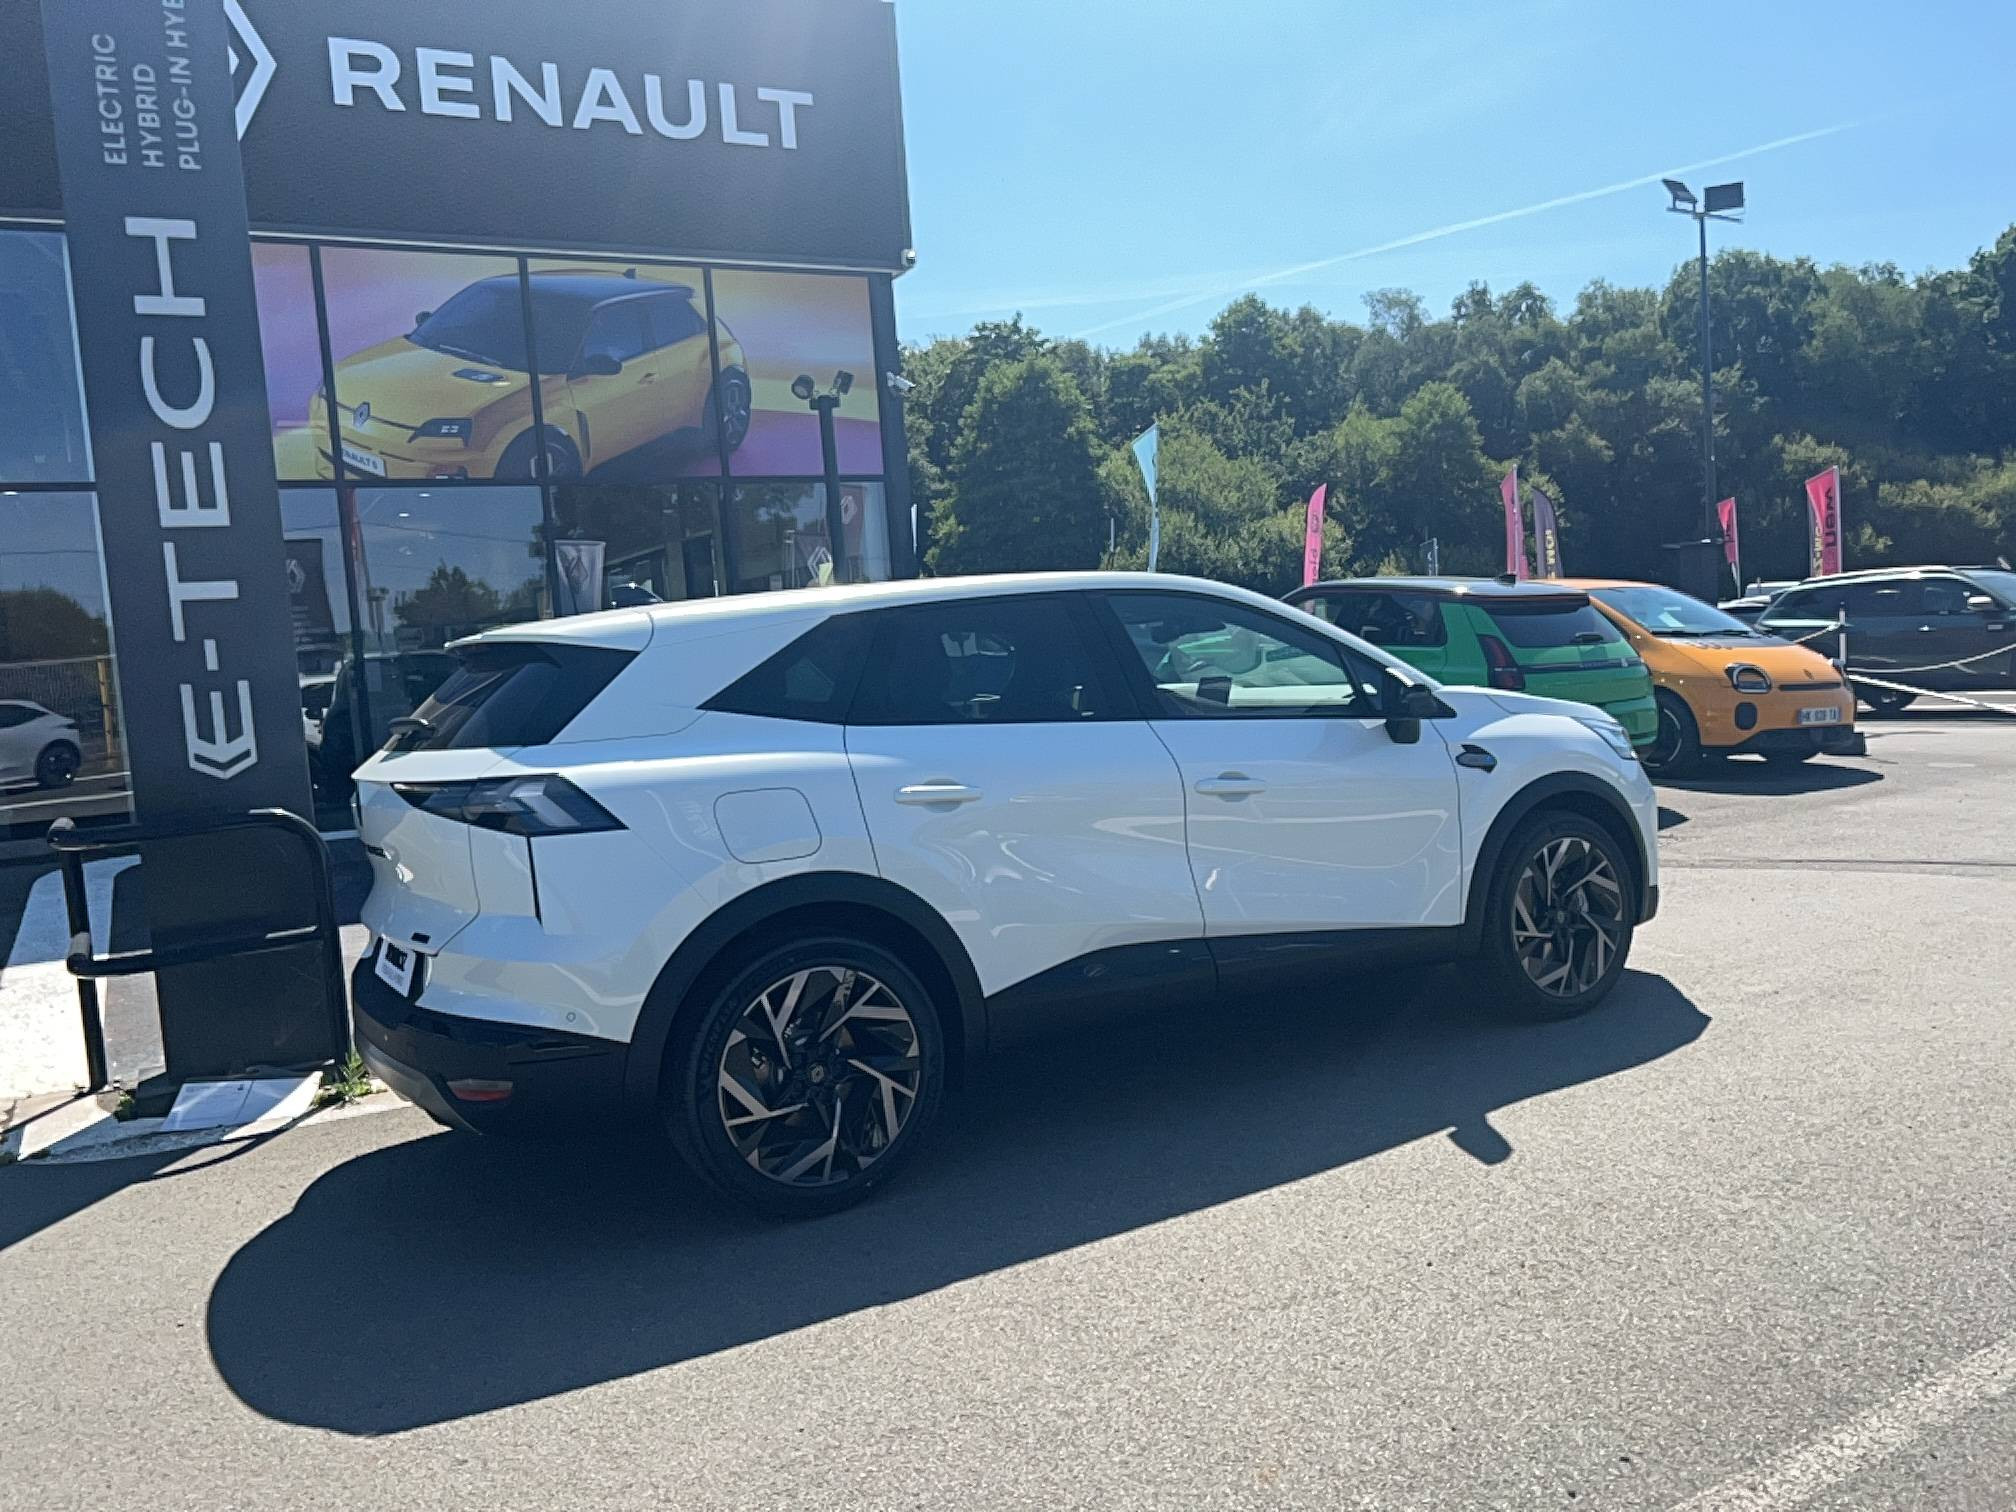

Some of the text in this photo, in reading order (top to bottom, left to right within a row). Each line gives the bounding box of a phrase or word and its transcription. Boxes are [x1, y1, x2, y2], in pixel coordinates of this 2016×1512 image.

[92, 34, 128, 164] ELECTRIC
[133, 63, 165, 168] HYBRID
[167, 56, 201, 170] PLUG-IN
[327, 37, 814, 150] RENAULT
[124, 216, 258, 780] E-TECH
